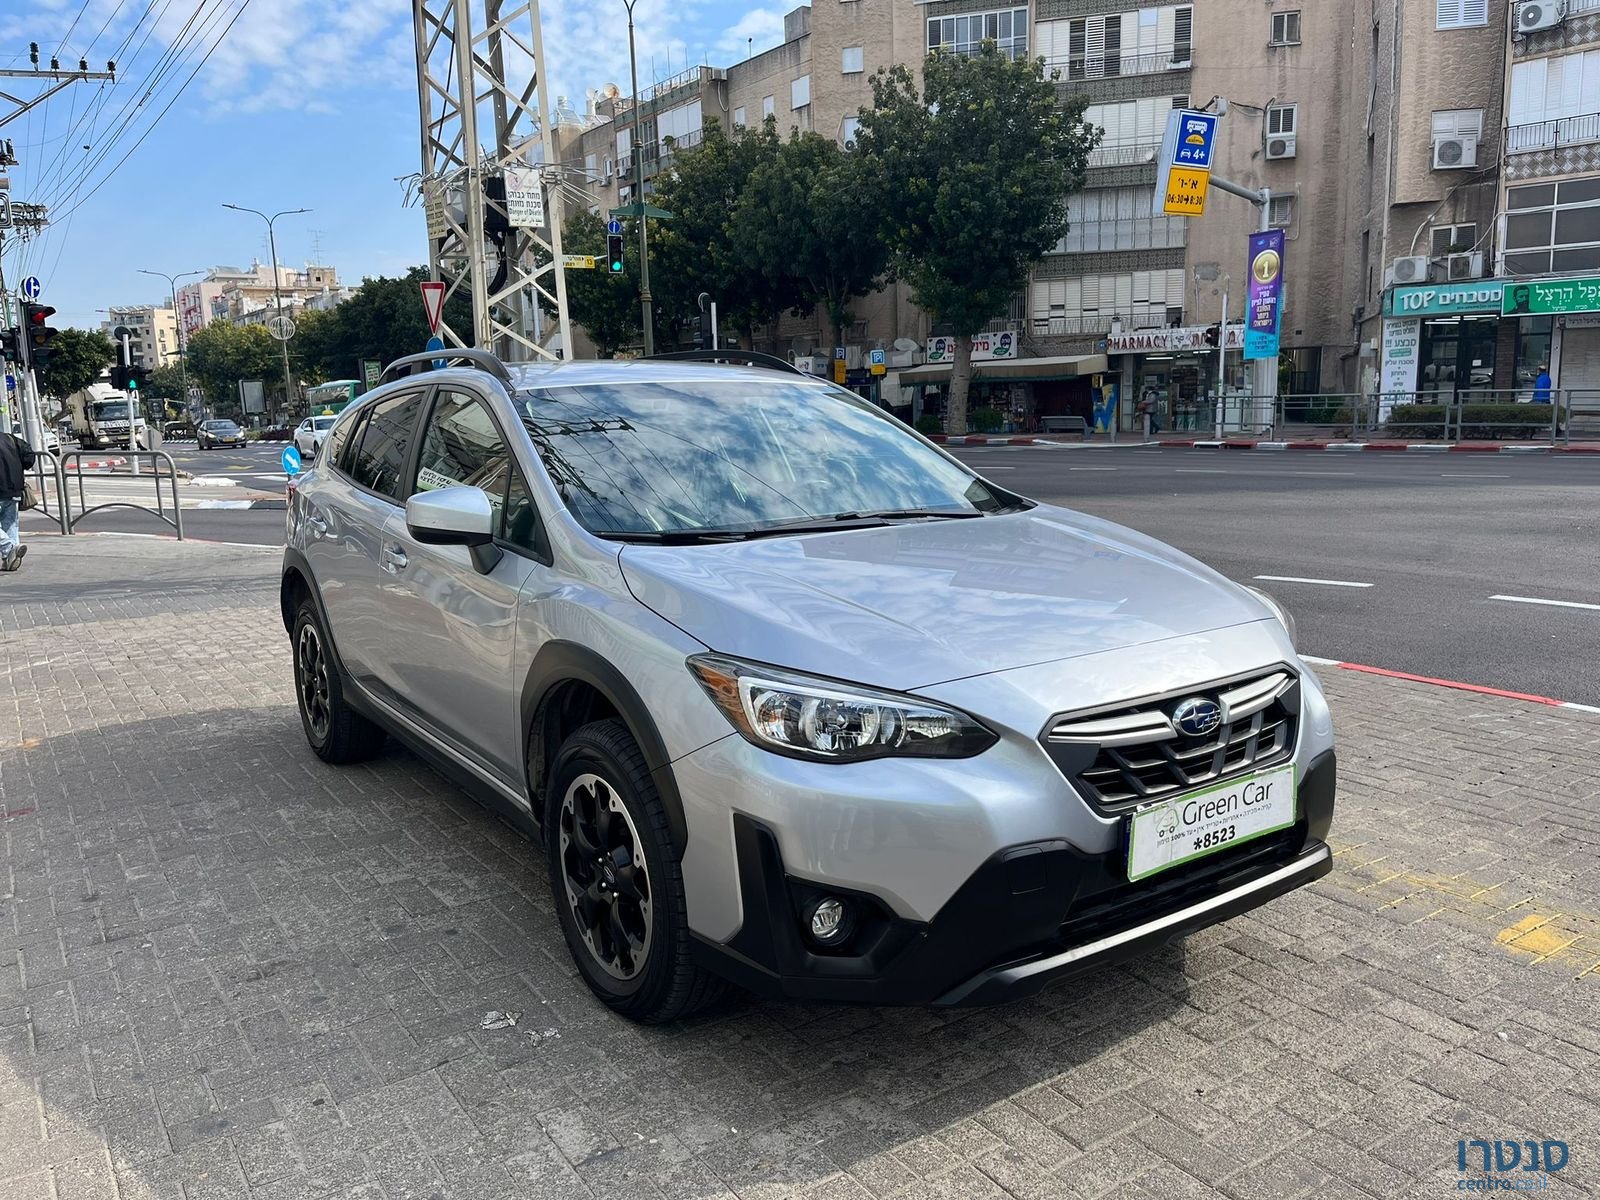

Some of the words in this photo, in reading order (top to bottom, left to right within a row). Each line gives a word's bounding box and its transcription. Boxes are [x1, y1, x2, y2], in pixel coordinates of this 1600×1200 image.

[1193, 149, 1205, 159] 4+
[1167, 193, 1184, 203] 06:30
[1190, 195, 1202, 205] 8:30
[1262, 261, 1269, 278] 1
[1400, 290, 1436, 310] TOP
[1107, 335, 1168, 350] PHARMACY
[1394, 338, 1417, 347] מבצע
[1182, 795, 1238, 826] Green
[1242, 782, 1273, 806] Car
